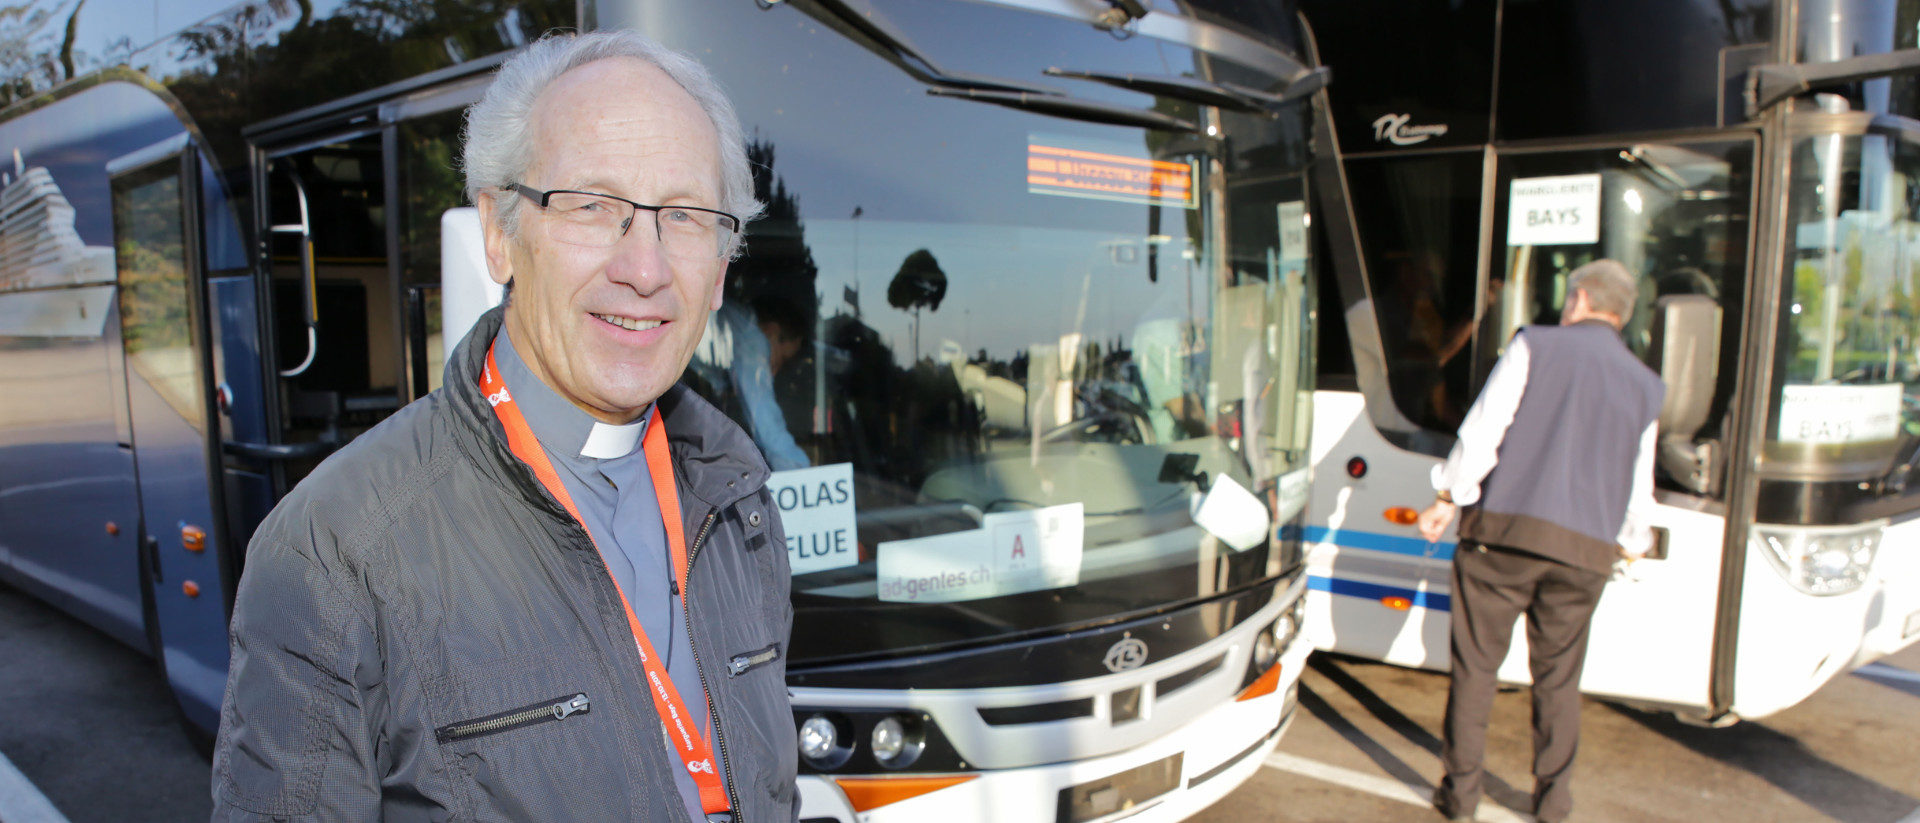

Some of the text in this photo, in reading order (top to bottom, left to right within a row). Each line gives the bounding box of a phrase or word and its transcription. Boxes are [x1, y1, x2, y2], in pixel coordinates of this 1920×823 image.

[1527, 207, 1581, 227] BAYS
[770, 479, 849, 511] OLAS
[1011, 534, 1026, 560] A
[668, 703, 678, 719] Bays
[675, 718, 694, 751] Marguerite
